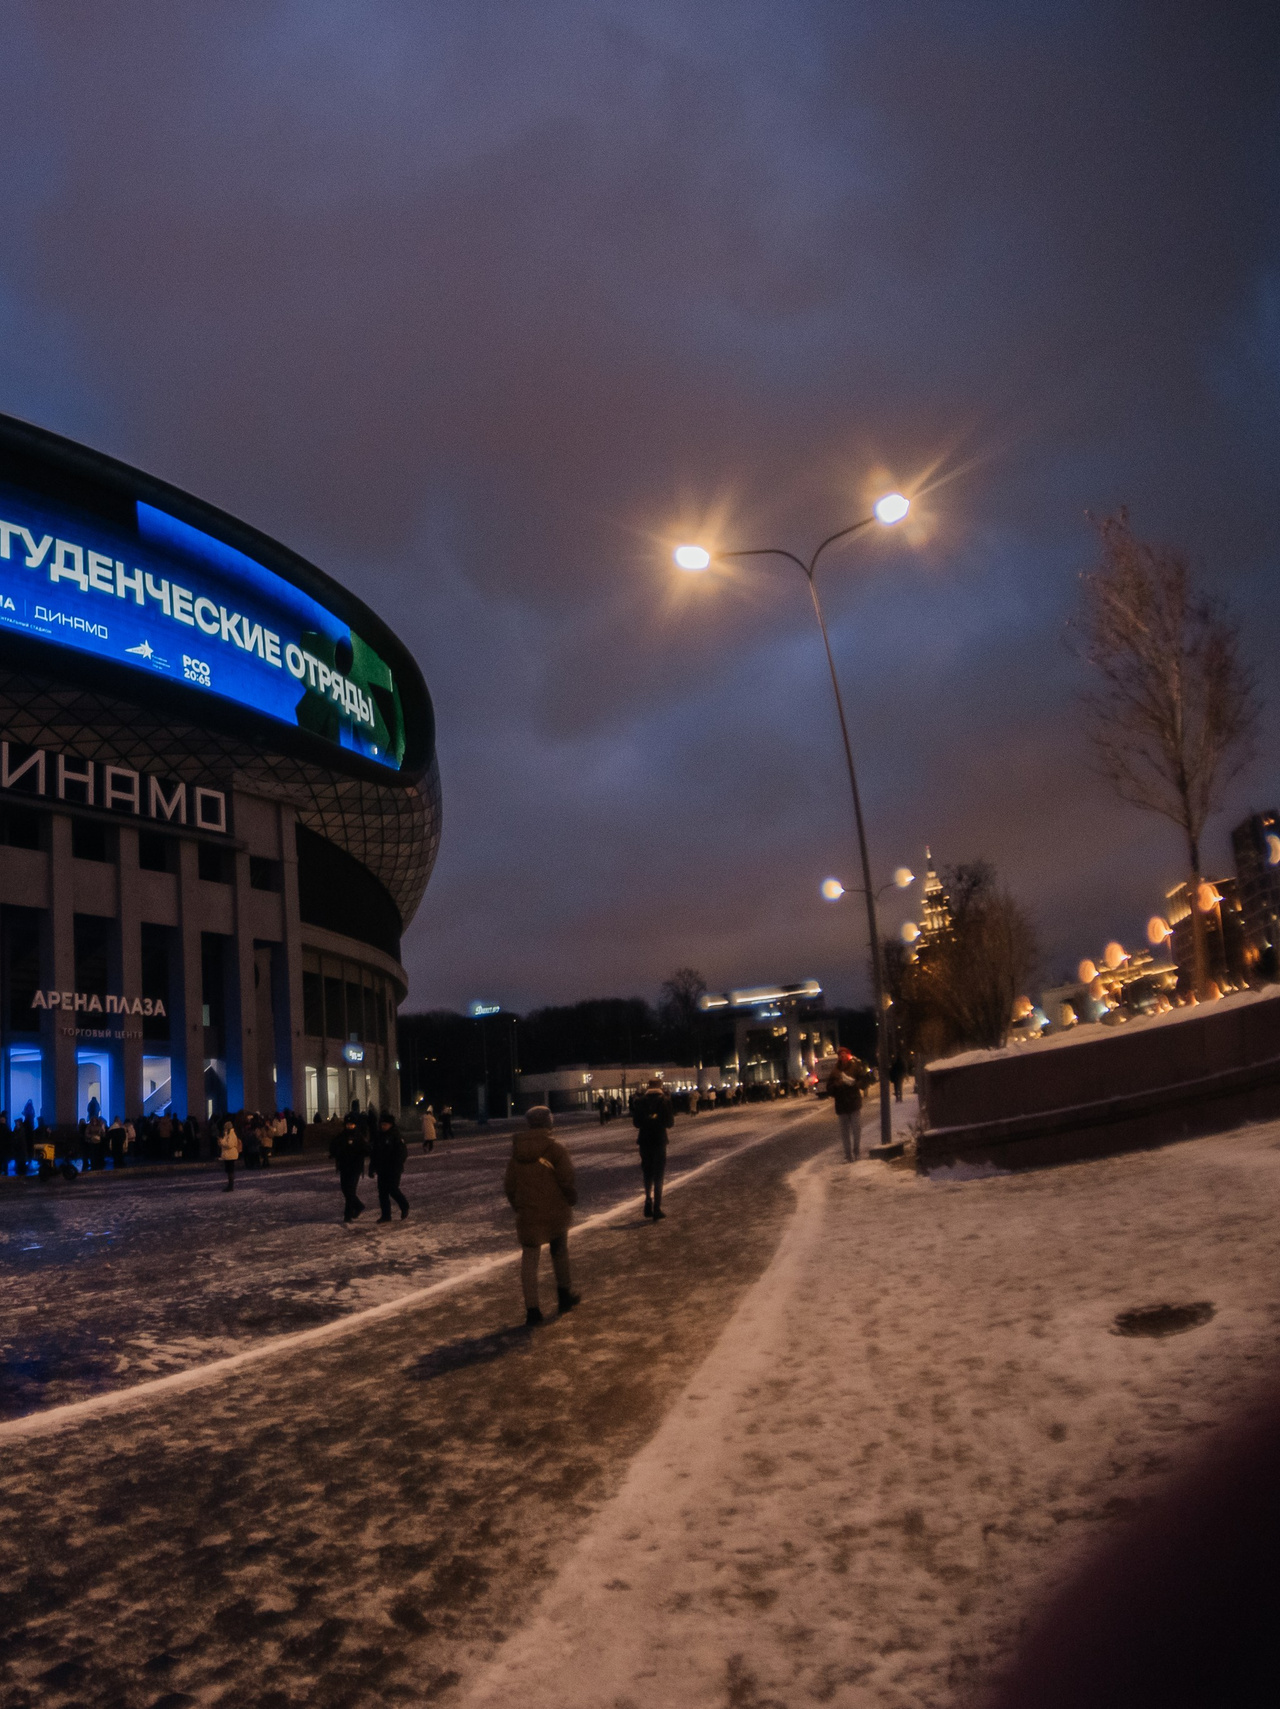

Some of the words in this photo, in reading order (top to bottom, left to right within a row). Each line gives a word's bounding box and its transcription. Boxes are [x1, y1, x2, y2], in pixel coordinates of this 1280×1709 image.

[34, 605, 108, 639] ДИНАМО
[182, 654, 211, 676] РСО
[183, 667, 211, 687] 20:65
[286, 643, 375, 728] ОТРЯДЫ
[31, 990, 103, 1013] АРЕНА
[105, 994, 167, 1017] ПЛАЗА
[62, 1027, 111, 1038] ТОРГОВЫЙ
[115, 1030, 143, 1039] ЦЕНТР
